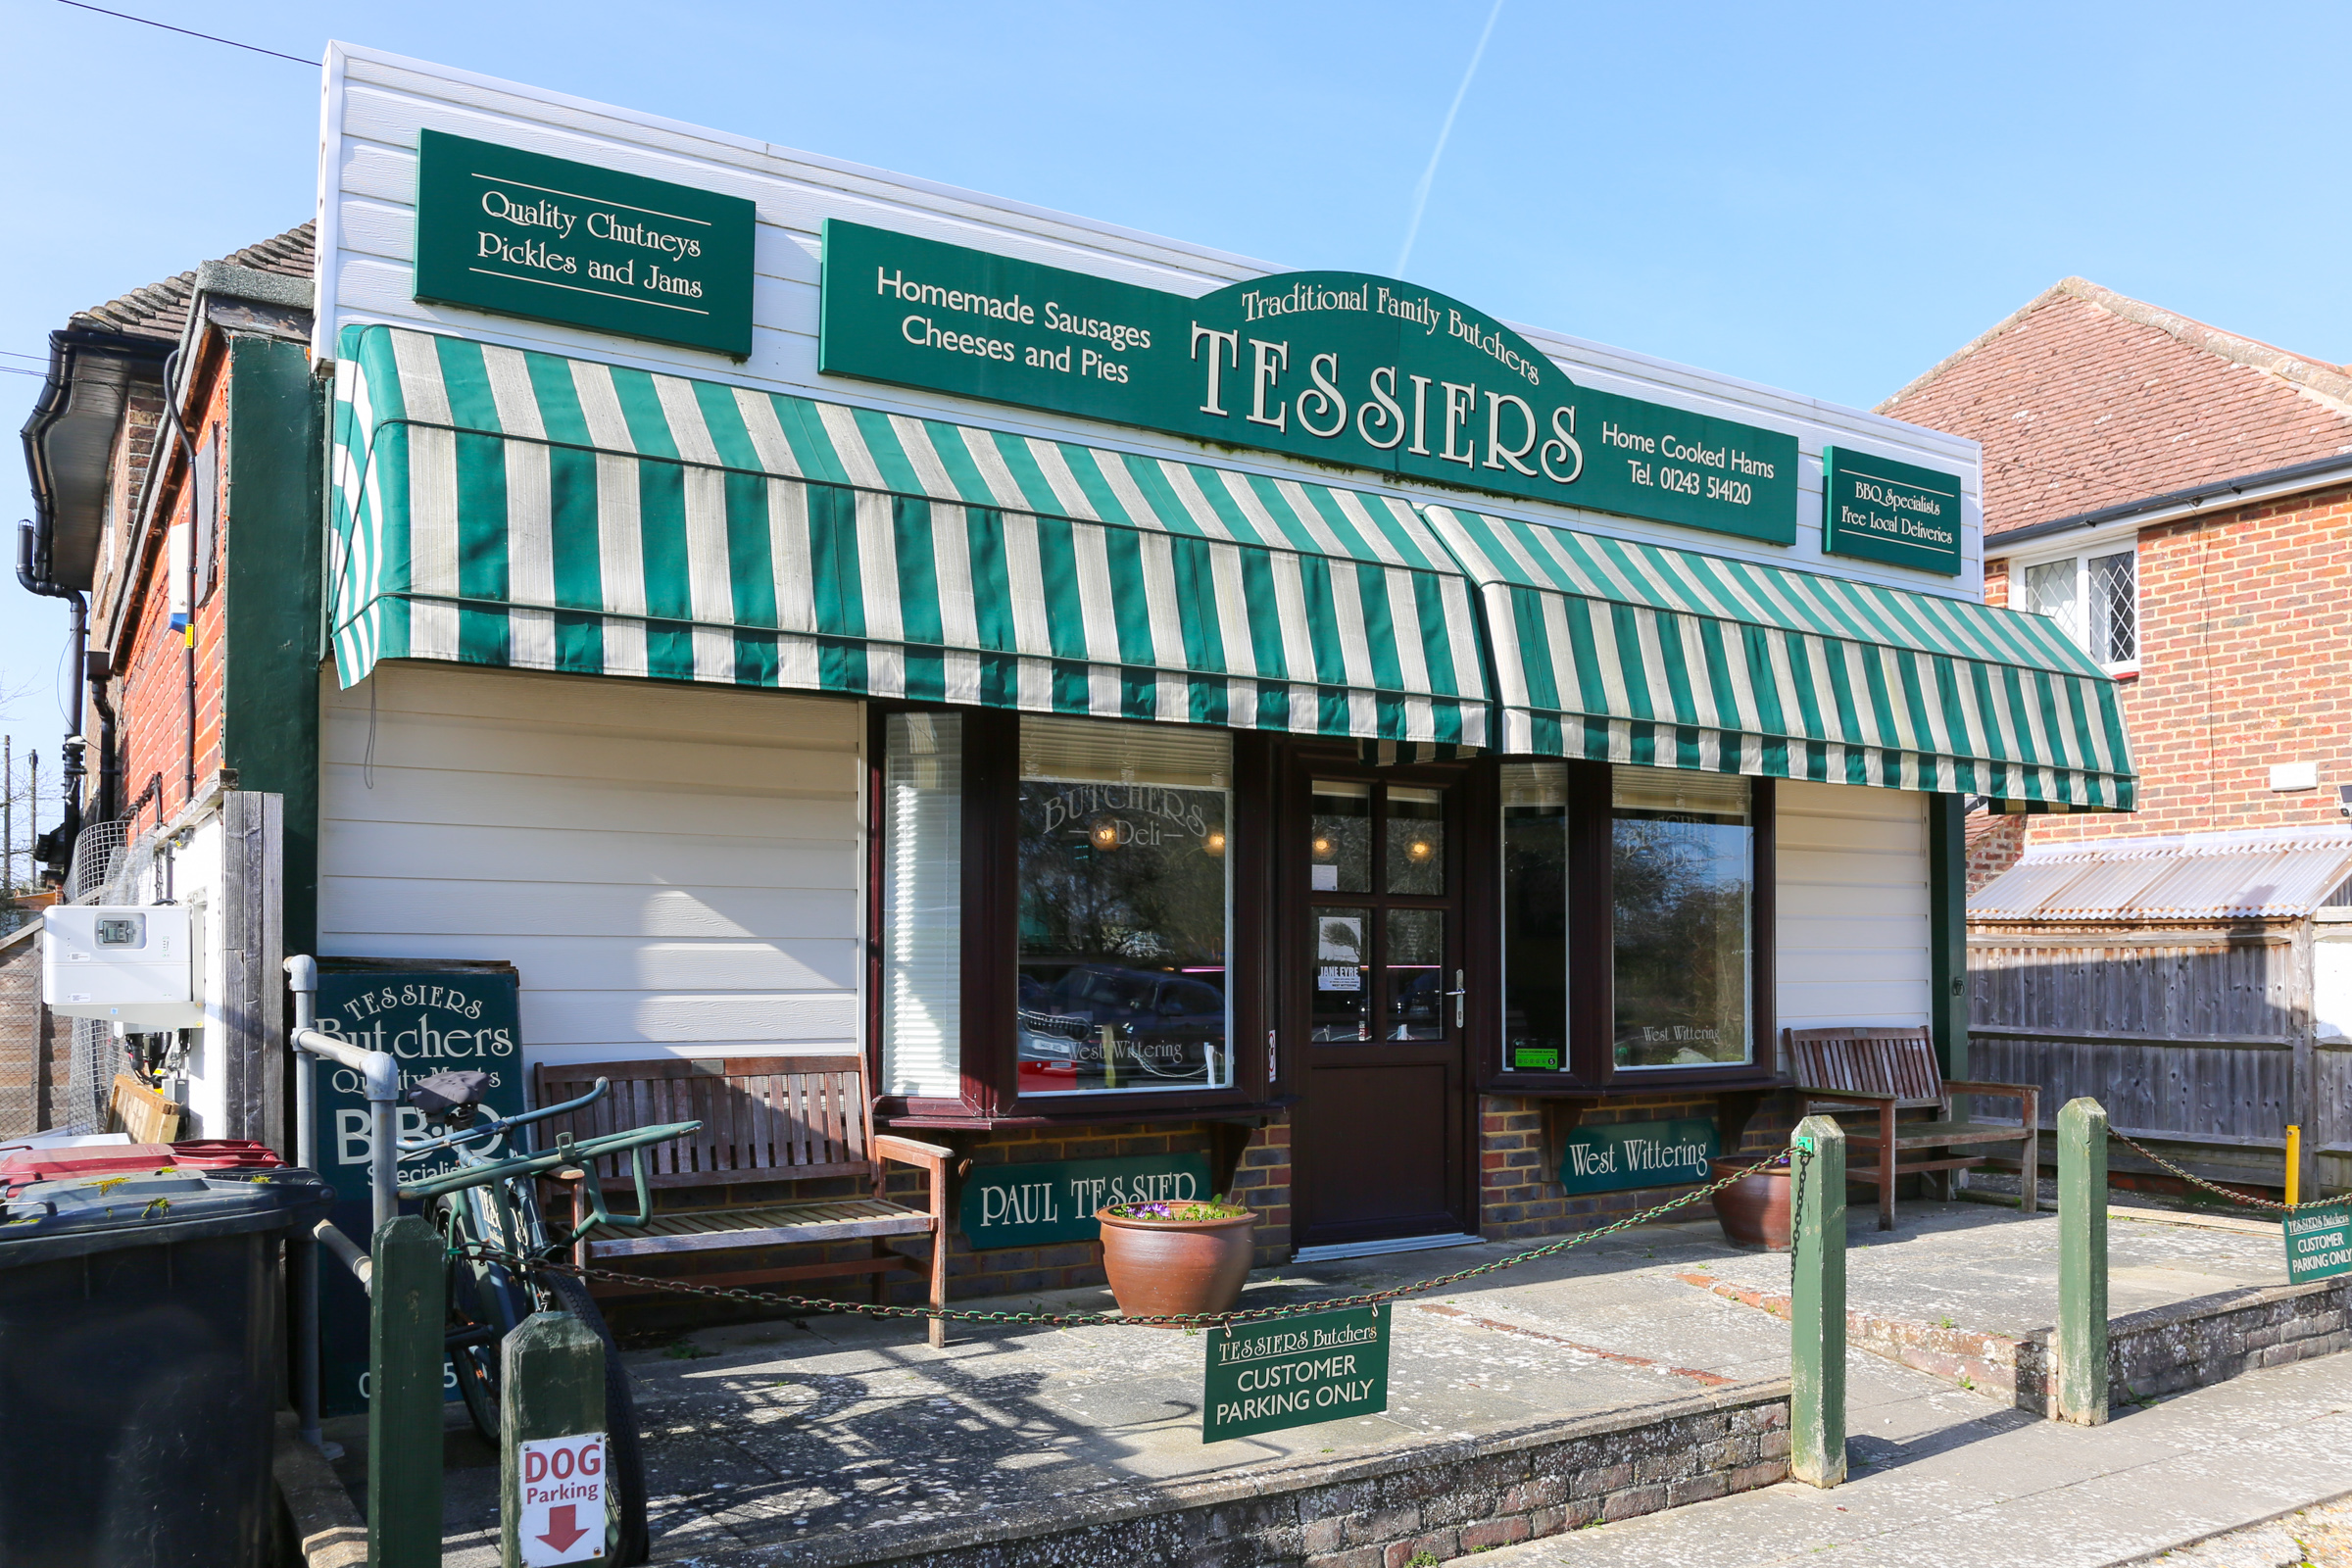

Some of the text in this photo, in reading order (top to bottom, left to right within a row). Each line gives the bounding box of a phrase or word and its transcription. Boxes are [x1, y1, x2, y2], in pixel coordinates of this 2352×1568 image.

[481, 190, 701, 262] Quality Chutneys
[477, 231, 703, 298] Pickles and Jams
[877, 266, 1152, 352] Homemade Sausages
[901, 315, 1129, 384] Cheeses and Pies
[1242, 282, 1541, 386] Traditional Family Butchers
[1191, 319, 1584, 484] TESSIERS
[1602, 421, 1775, 479] Home Cooked Hams
[1627, 459, 1751, 506] Tel. 01243 514120
[1855, 481, 1940, 516] BBQ Specialists
[1841, 506, 1953, 544] Free Local Deliveries
[1043, 783, 1207, 838] BUTCHERS
[1114, 820, 1161, 846] Deli
[1320, 965, 1358, 977] JANE EYRE
[343, 984, 483, 1022] TESSIERS
[316, 1013, 514, 1061] Butchers
[1068, 1040, 1183, 1064] West Wittering
[1642, 1025, 1720, 1045] West Wittering
[1569, 1137, 1708, 1177] West Wittering
[980, 1183, 1058, 1227] PAUL
[2292, 1248, 2352, 1274] PARKING ONLY
[2297, 1232, 2344, 1253] CUSTOMER
[1218, 1323, 1377, 1362] TESSIERS Butchers
[1237, 1354, 1356, 1393] CUSTOMER
[1216, 1378, 1374, 1426] PARKING ONLY
[524, 1444, 601, 1484] DOG
[526, 1482, 599, 1504] Parking
